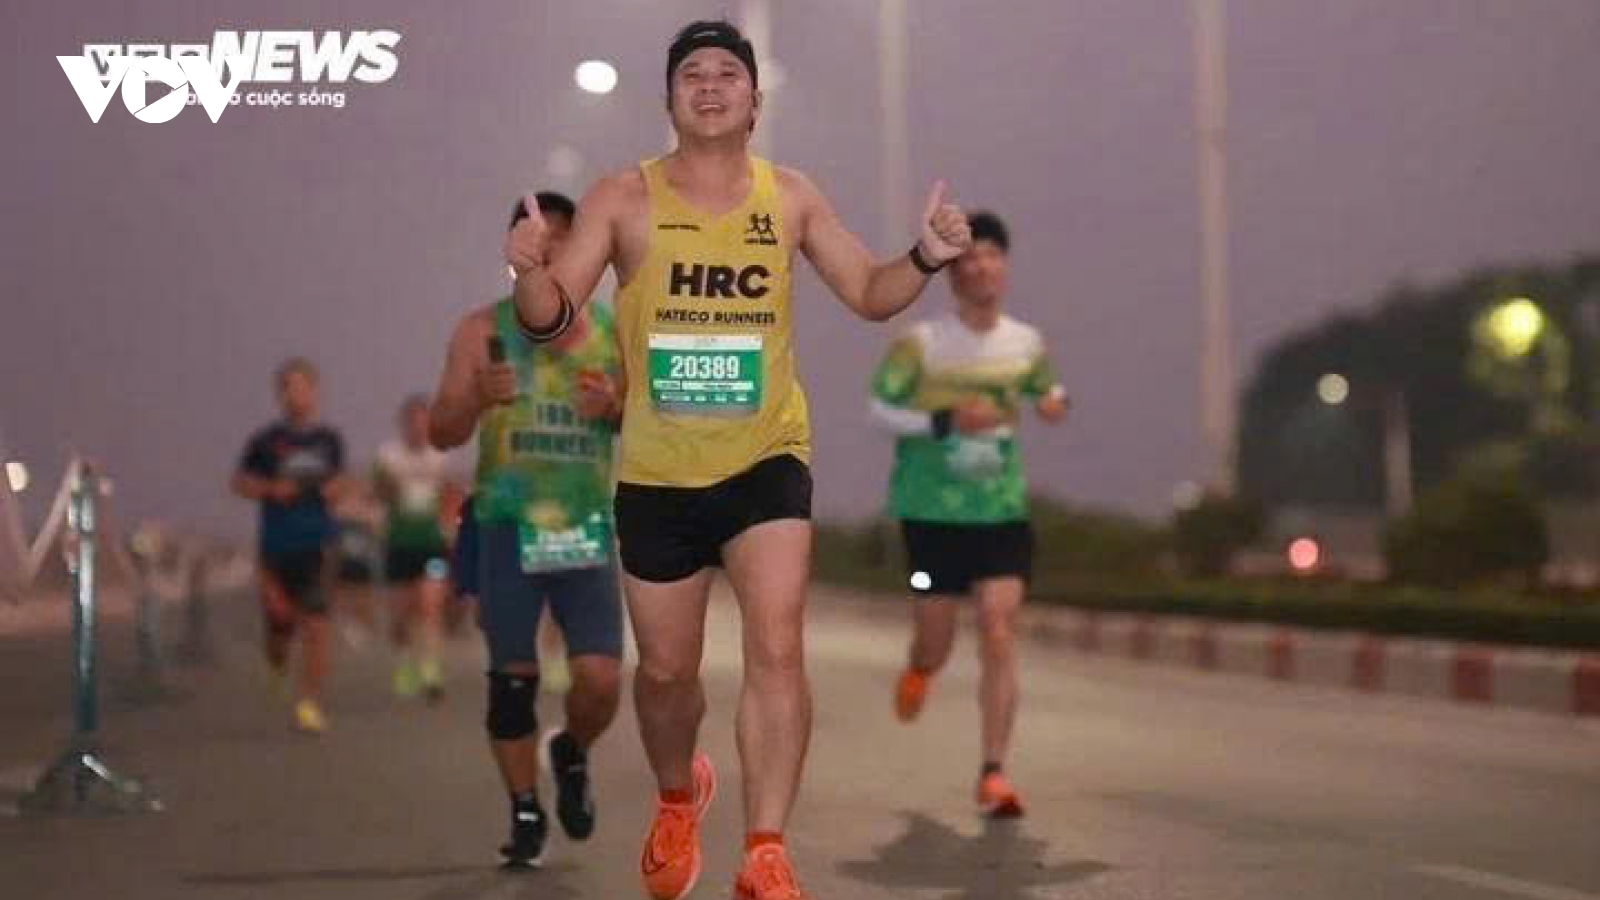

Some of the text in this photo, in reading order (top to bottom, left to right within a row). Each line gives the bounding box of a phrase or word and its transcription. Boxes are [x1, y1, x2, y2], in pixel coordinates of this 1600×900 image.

[669, 262, 770, 299] HRC
[656, 308, 710, 323] HATECO
[670, 355, 740, 380] 20389
